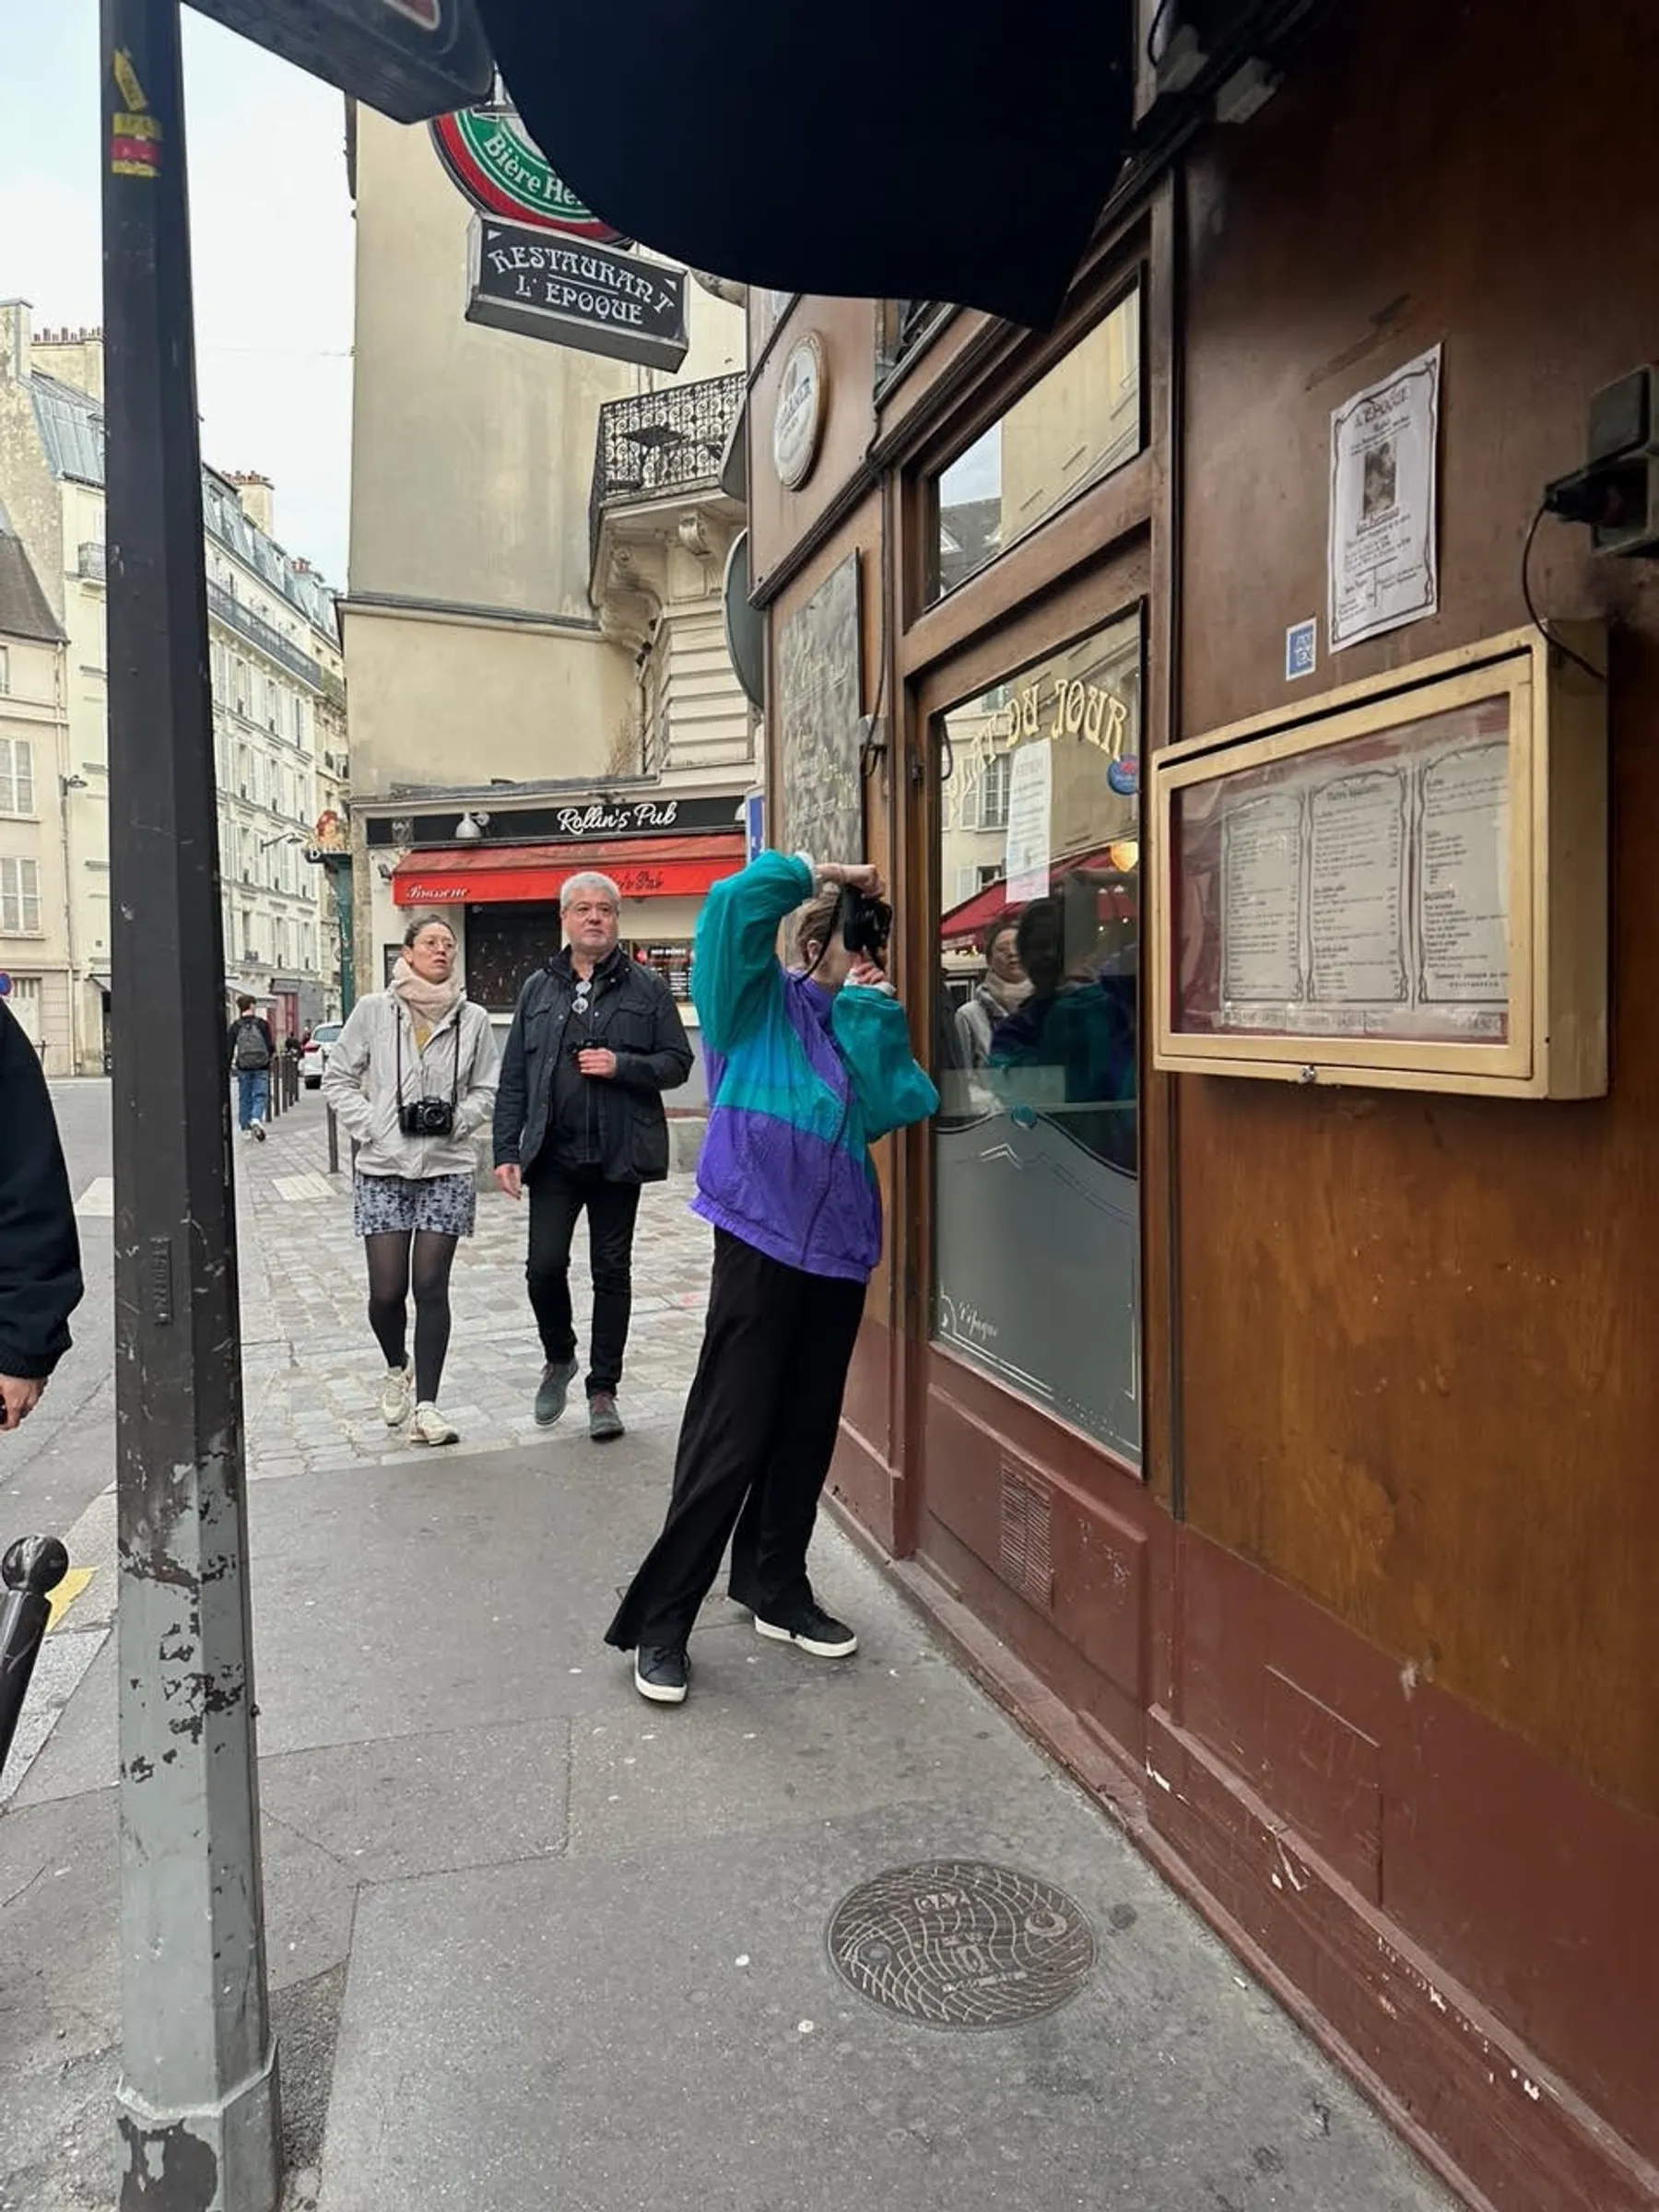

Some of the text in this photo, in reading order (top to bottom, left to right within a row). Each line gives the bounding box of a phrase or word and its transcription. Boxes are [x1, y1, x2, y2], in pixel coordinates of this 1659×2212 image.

[484, 132, 582, 206] Bière He
[488, 246, 675, 314] RESTAURANT
[1006, 684, 1040, 748] DU
[1051, 678, 1127, 763] JOUR
[556, 801, 677, 835] Rollin's Pub
